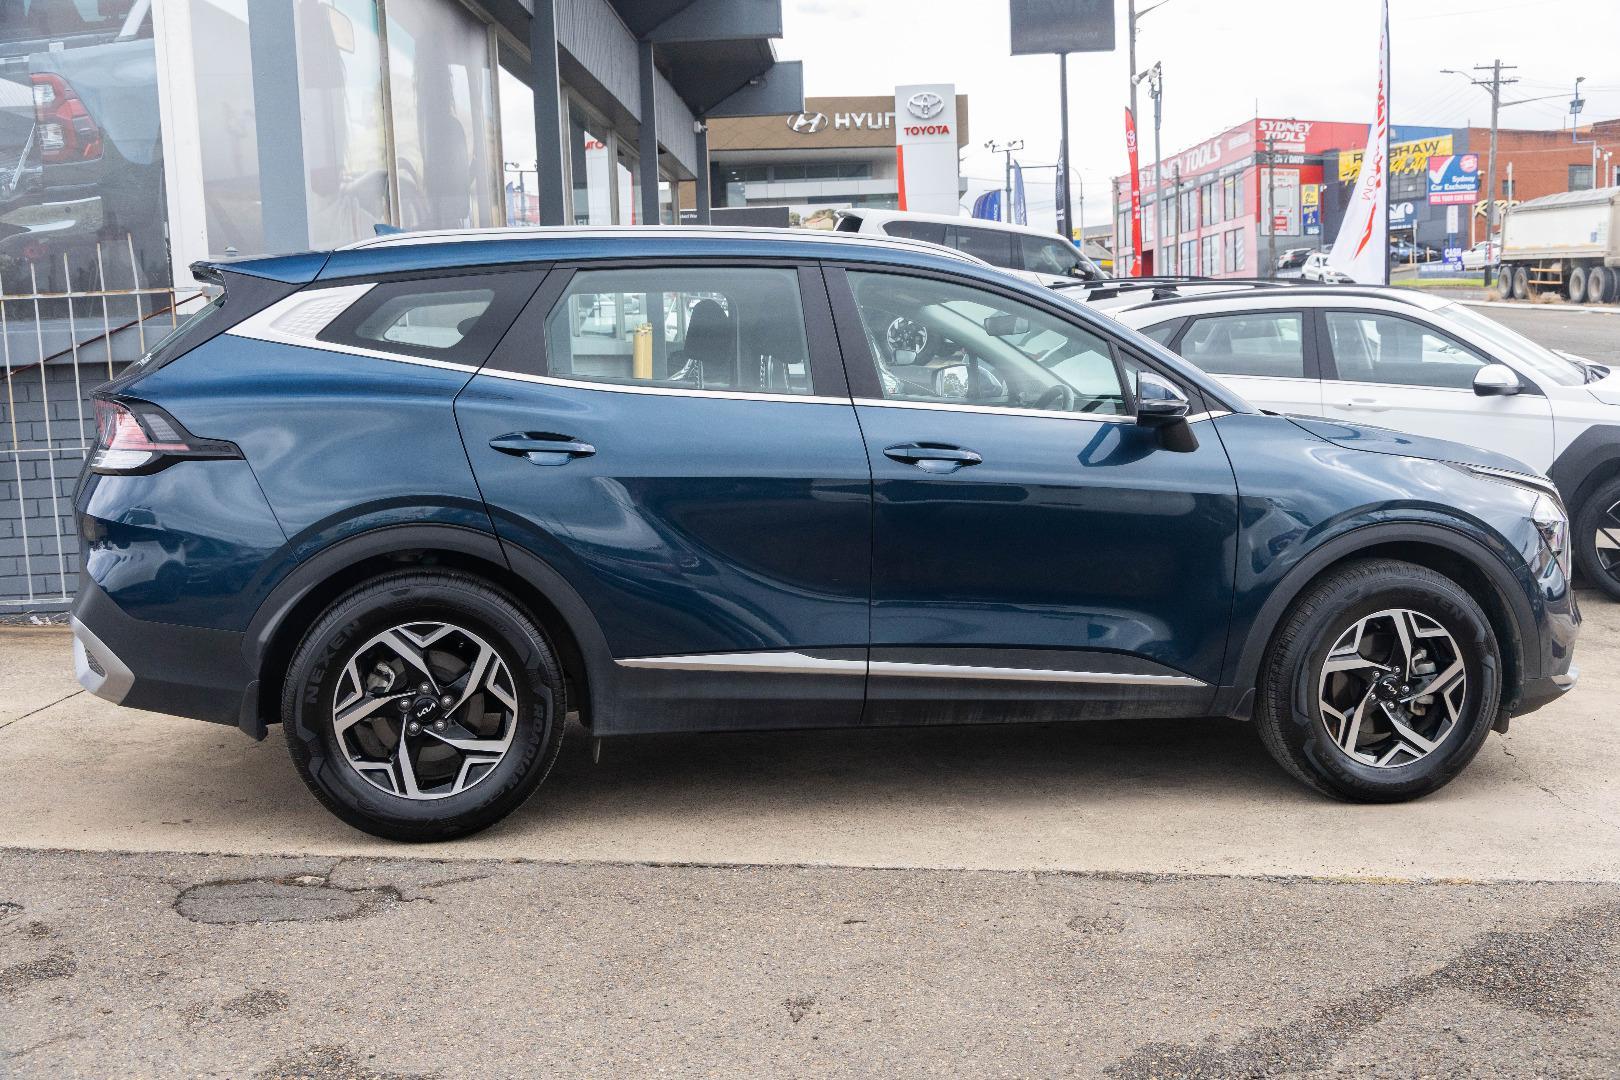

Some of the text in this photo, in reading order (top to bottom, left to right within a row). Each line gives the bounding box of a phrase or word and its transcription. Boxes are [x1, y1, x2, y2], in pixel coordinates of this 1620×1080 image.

[835, 111, 896, 131] HYUN
[1258, 121, 1313, 132] SYDNEY
[903, 125, 950, 136] TOYOTA
[1264, 131, 1306, 142] TOOLS
[1183, 139, 1222, 174] TOOLS
[1353, 141, 1440, 164] RSHAW
[1452, 175, 1476, 184] Sydney
[1444, 183, 1476, 191] Exchange
